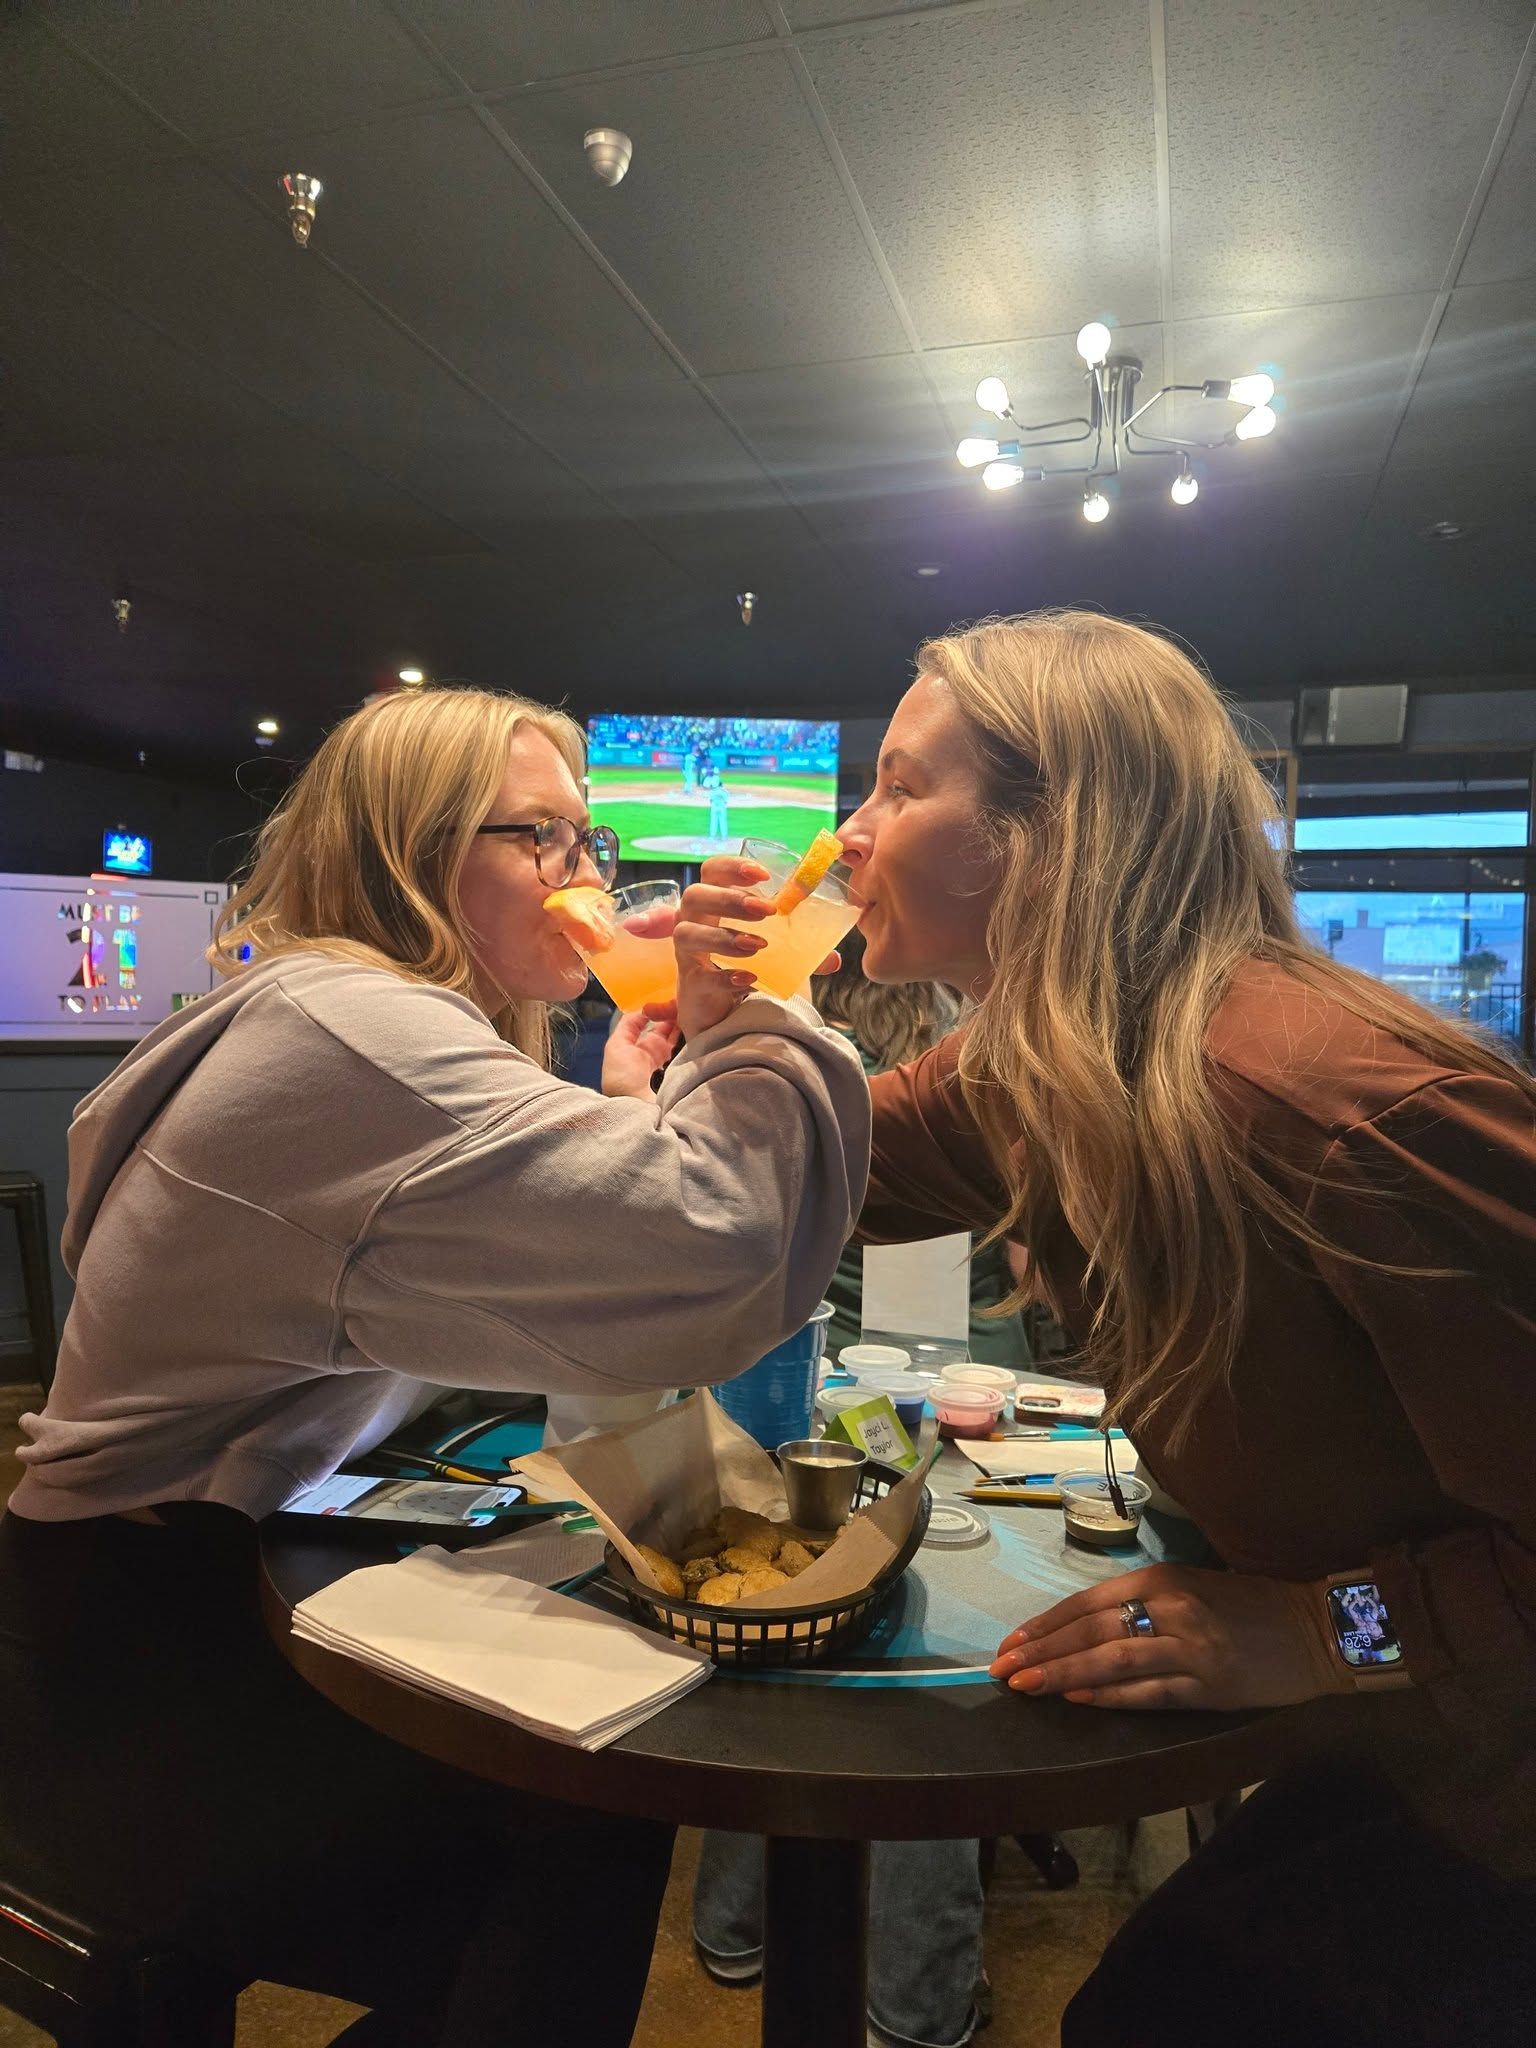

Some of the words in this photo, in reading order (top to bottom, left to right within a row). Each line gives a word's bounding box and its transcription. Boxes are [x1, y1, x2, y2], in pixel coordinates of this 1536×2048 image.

[58, 903, 113, 921] MUST
[119, 904, 142, 924] BE
[67, 926, 137, 988] 21
[58, 994, 86, 1013] TO
[92, 994, 142, 1012] PLAY
[870, 1440, 894, 1455] Taylor
[1345, 1635, 1371, 1649] 6:26
